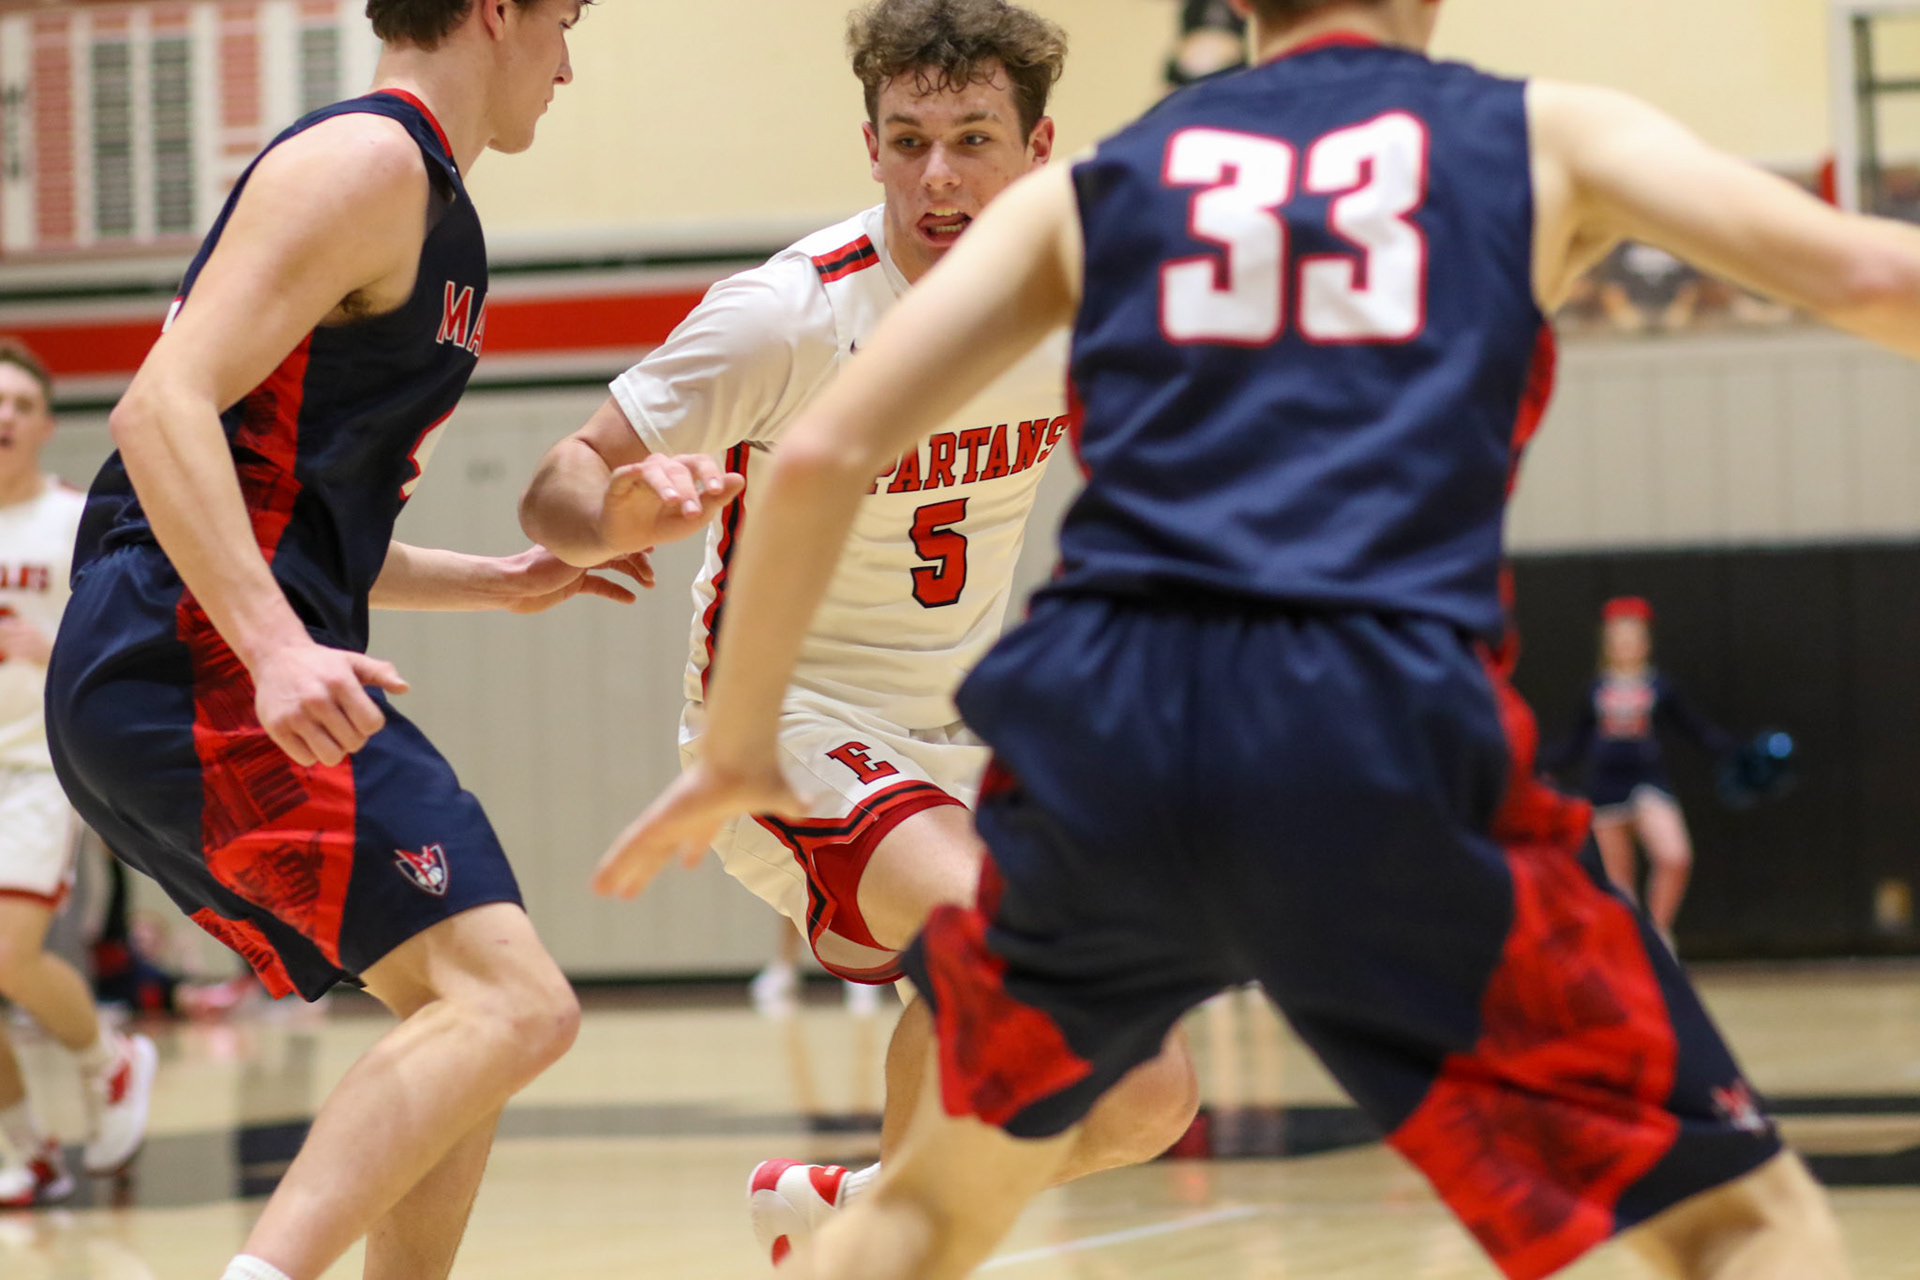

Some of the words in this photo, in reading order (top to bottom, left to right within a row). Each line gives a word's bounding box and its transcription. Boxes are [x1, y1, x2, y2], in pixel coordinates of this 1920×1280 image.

[1159, 109, 1430, 346] 33
[908, 497, 970, 608] 5
[825, 741, 900, 785] E
